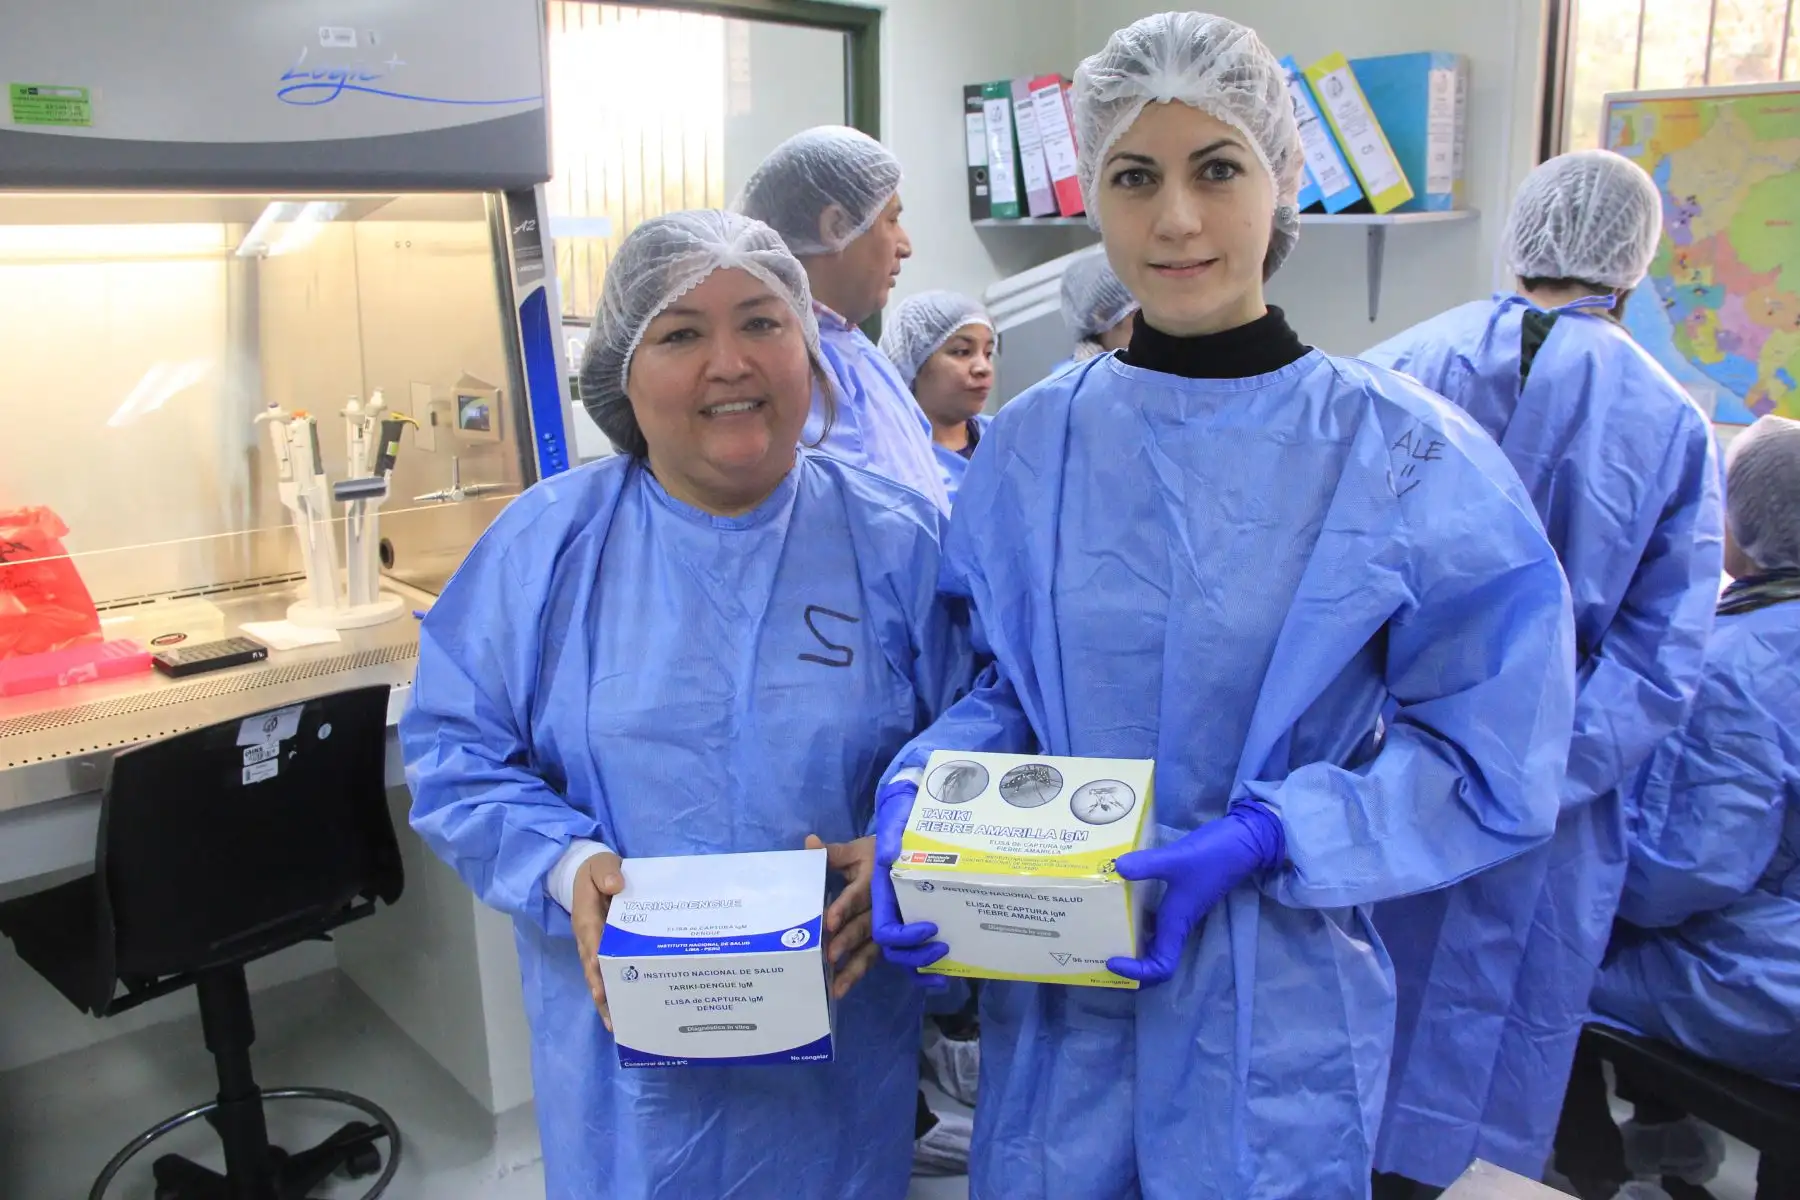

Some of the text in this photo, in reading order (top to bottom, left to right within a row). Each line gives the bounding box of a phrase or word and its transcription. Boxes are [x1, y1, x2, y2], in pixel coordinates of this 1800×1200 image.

[1391, 429, 1446, 461] ALE
[922, 807, 972, 822] TARIKI
[916, 820, 1090, 843] FIEBRE AMARILLA IgM
[942, 886, 988, 895] INSTITUTO
[989, 891, 1036, 900] NACIONAL
[965, 900, 991, 909] ELISA
[1006, 905, 1049, 916] CAPTURA
[620, 912, 648, 924] IgM
[978, 909, 1056, 923] FIEBRE AMARILLA
[643, 971, 690, 979] INSTITUTO
[691, 969, 737, 977] NACIONAL
[754, 967, 784, 975] SALUD
[669, 981, 754, 991] TARIKI-DENGUE IgM
[664, 998, 691, 1006] ELISA
[696, 1004, 734, 1012] DENGUE
